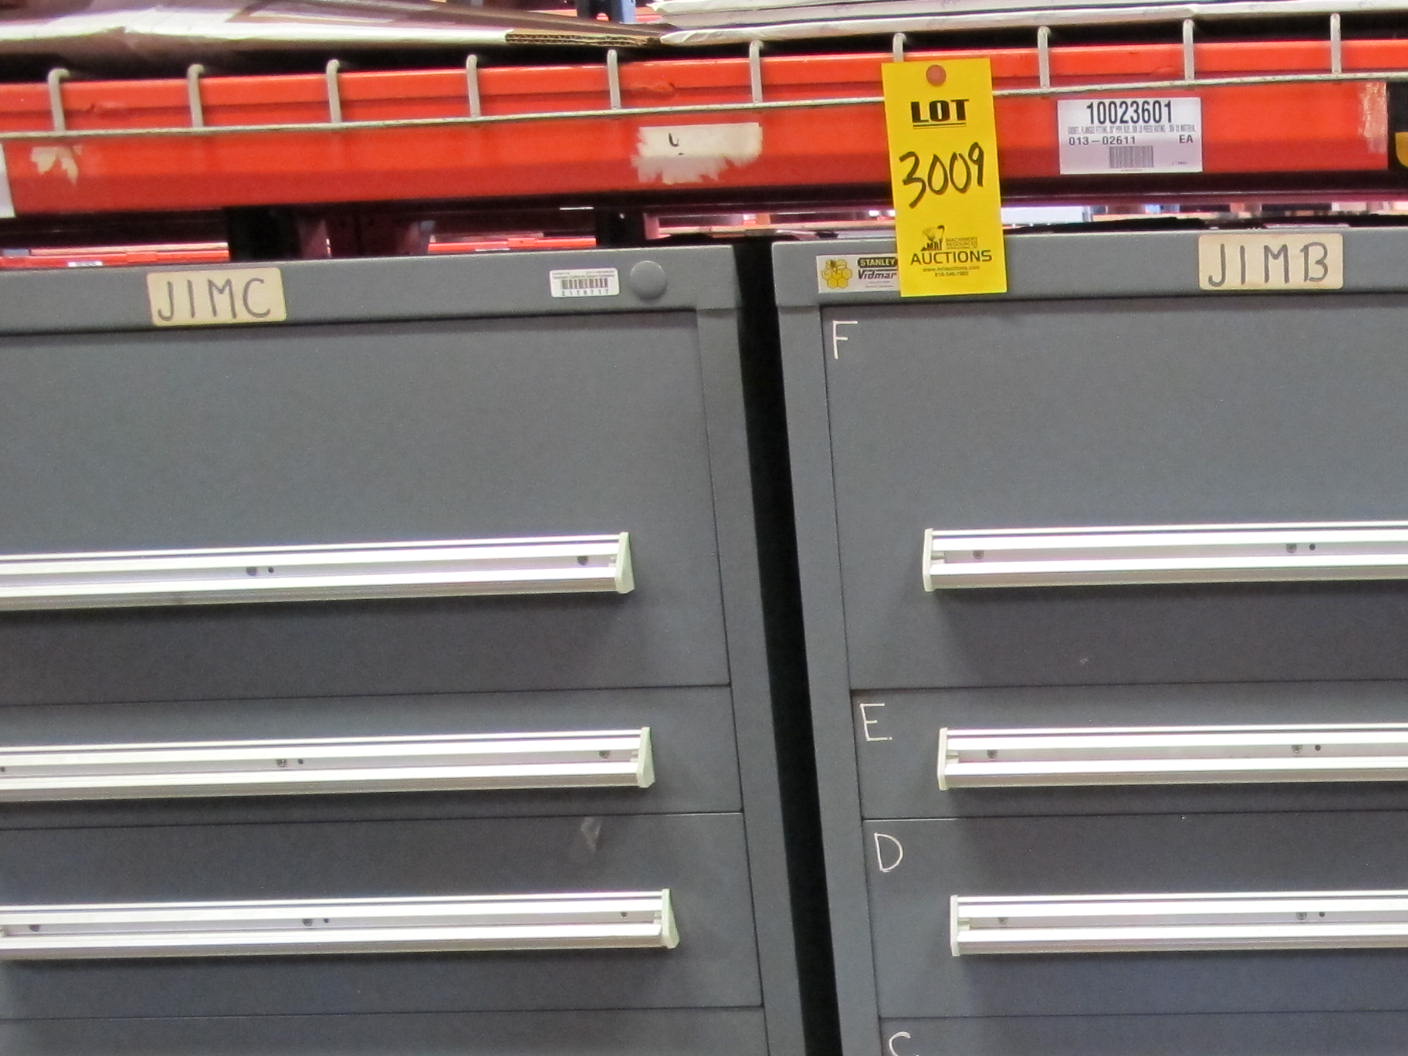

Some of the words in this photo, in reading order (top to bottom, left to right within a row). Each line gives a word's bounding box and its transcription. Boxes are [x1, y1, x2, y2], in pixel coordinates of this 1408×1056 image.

[911, 98, 970, 123] LOT
[1086, 100, 1172, 124] 10023601
[1179, 134, 1193, 143] EA
[898, 142, 985, 209] 3009
[859, 257, 897, 267] STANLEY
[910, 250, 992, 265] AUCTIONS
[1208, 241, 1329, 288] JIMB
[857, 269, 897, 280] Vidmar
[157, 277, 271, 321] JIMC
[832, 320, 858, 360] F
[874, 832, 904, 873] D
